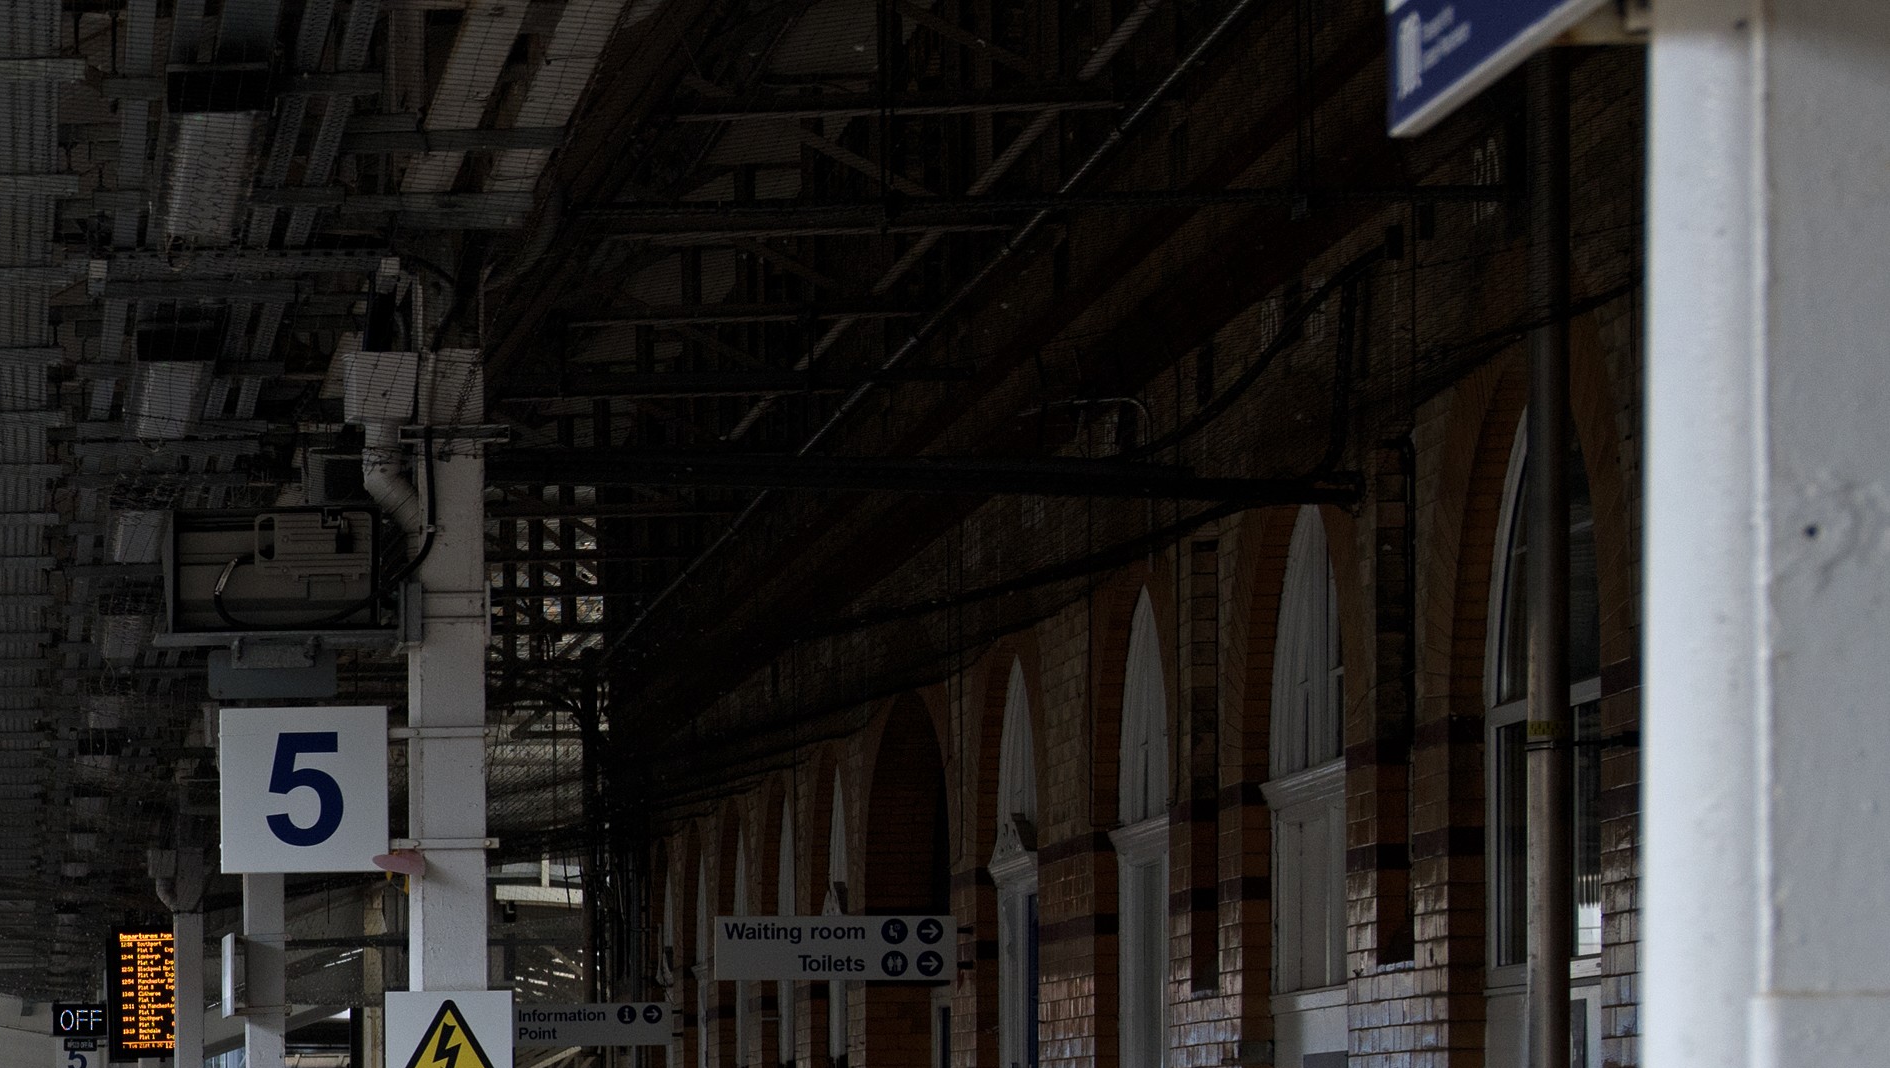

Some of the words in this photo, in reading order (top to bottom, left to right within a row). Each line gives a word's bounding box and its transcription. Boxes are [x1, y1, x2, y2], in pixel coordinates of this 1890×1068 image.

[266, 732, 344, 846] 5
[725, 923, 801, 944] Waiting
[811, 926, 865, 940] room
[798, 955, 865, 972] Toilets
[60, 1010, 102, 1030] OFF
[519, 1010, 606, 1022] Information
[519, 1027, 557, 1040] Point
